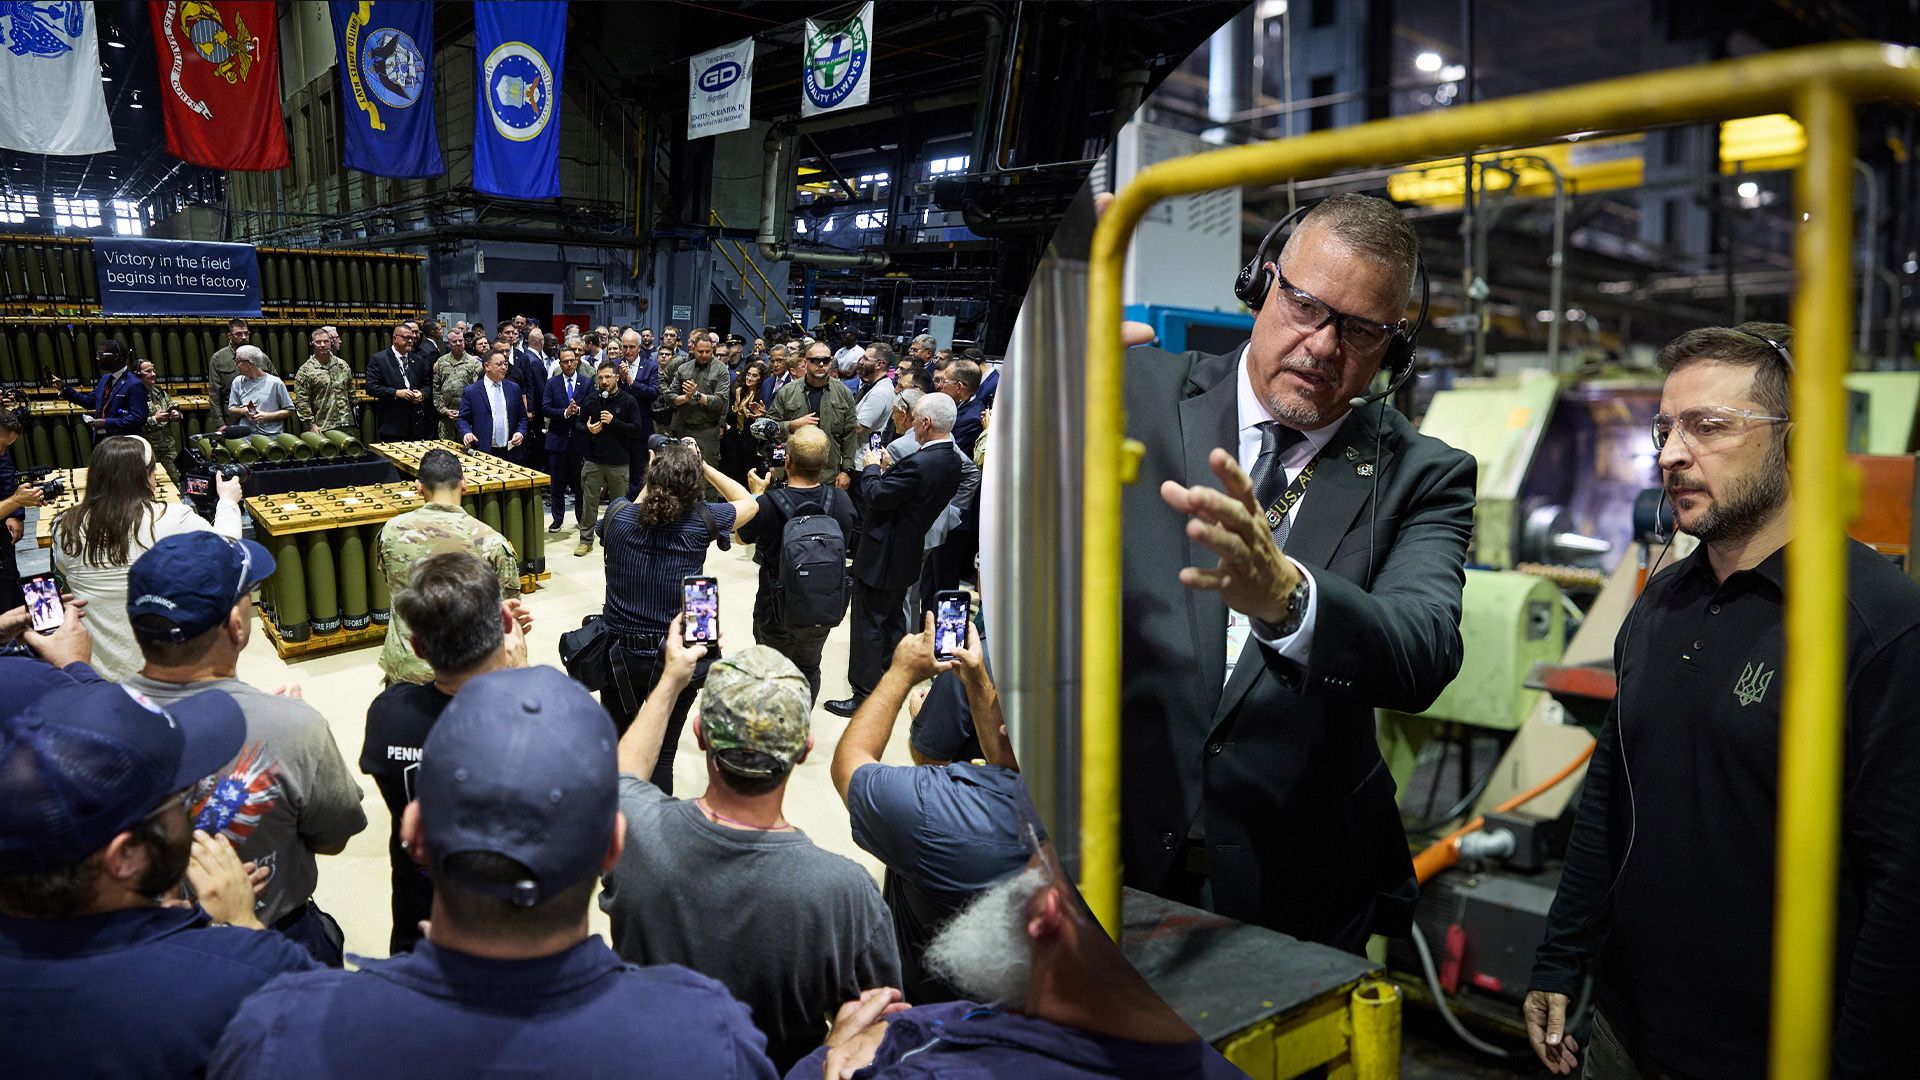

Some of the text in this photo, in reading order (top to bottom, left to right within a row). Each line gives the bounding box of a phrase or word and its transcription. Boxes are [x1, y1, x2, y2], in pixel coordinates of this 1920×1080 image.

[167, 33, 182, 76] MARINE
[348, 18, 366, 104] UNITED STATES NAVY
[485, 62, 494, 79] AIR
[539, 64, 551, 96] UNITED
[703, 65, 737, 88] GD
[806, 74, 830, 103] QUALITY
[832, 60, 861, 101] ALWAYS
[172, 80, 197, 110] CORPS
[103, 250, 231, 270] Victory in the field
[106, 269, 251, 292] begins in the factory.
[1274, 490, 1301, 514] U.S.
[372, 612, 390, 621] FIRING
[387, 745, 424, 762] PENN
